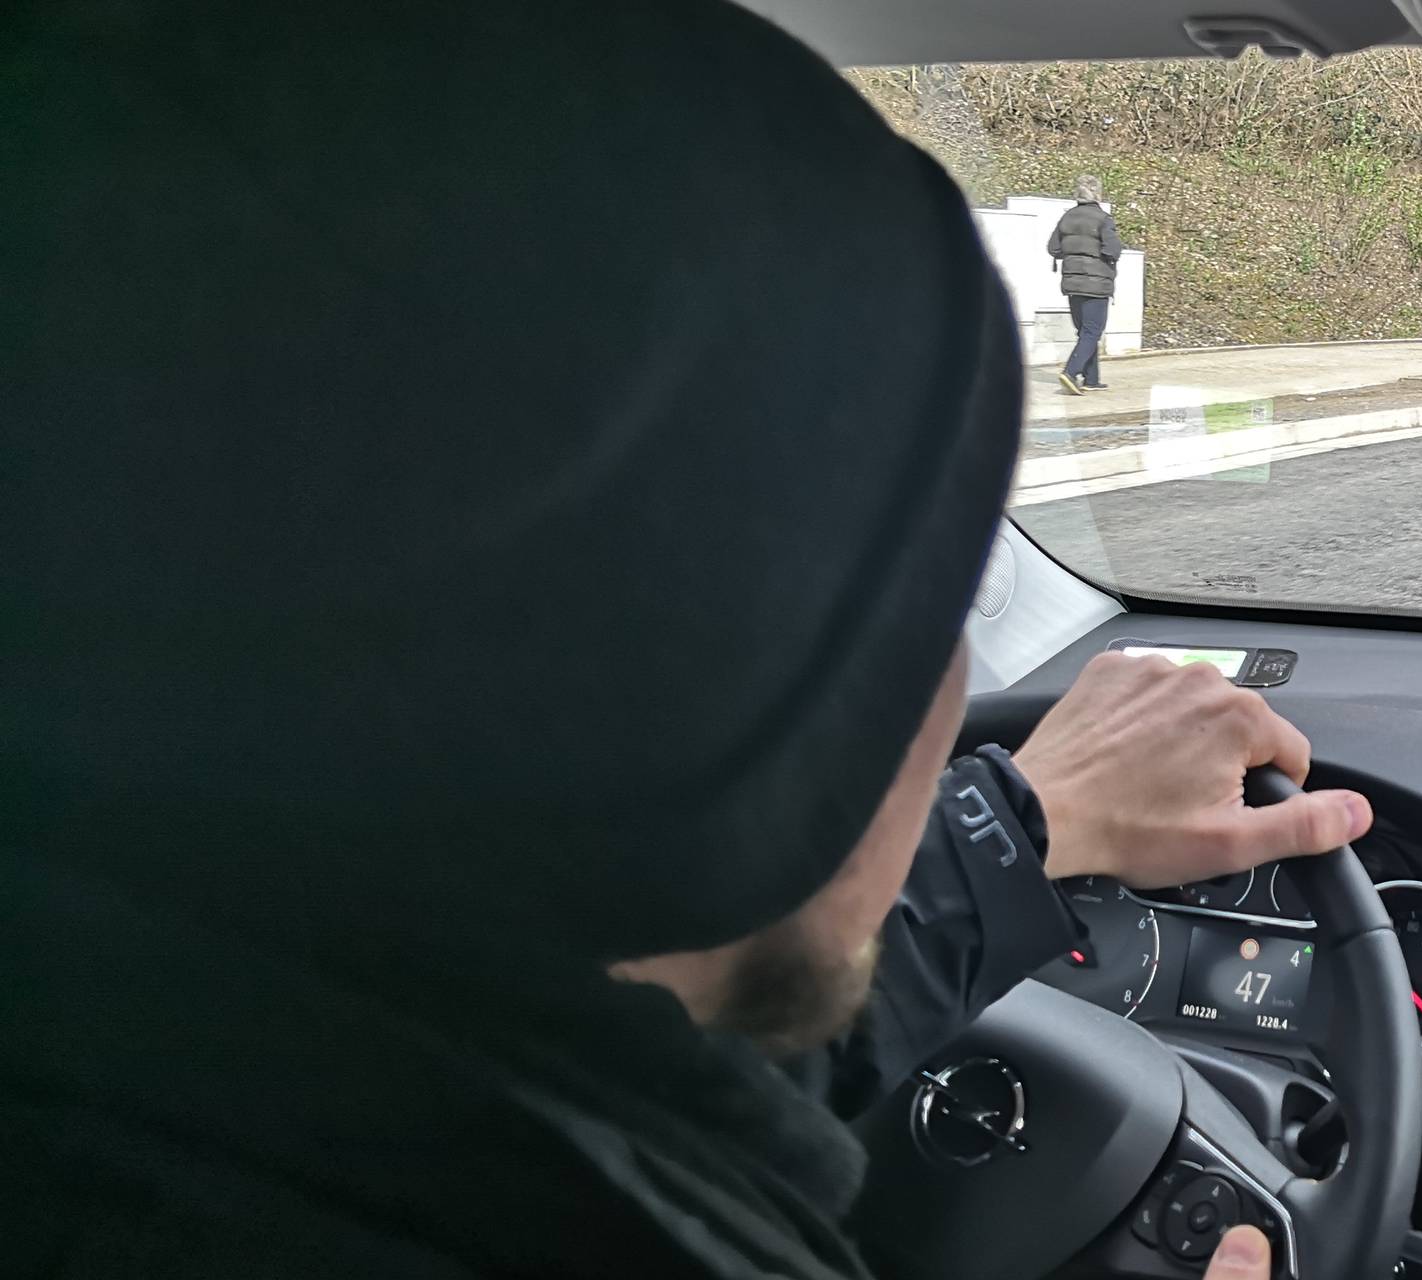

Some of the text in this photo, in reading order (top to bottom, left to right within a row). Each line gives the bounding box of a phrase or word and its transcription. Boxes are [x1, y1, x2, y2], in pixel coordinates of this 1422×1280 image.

[1138, 915, 1147, 930] 6
[1141, 954, 1150, 968] 7
[1289, 949, 1300, 968] 4
[1123, 988, 1133, 1003] 8
[1234, 970, 1272, 1005] 47
[1182, 1003, 1218, 1020] 001228
[1256, 1014, 1288, 1030] 1228.4
